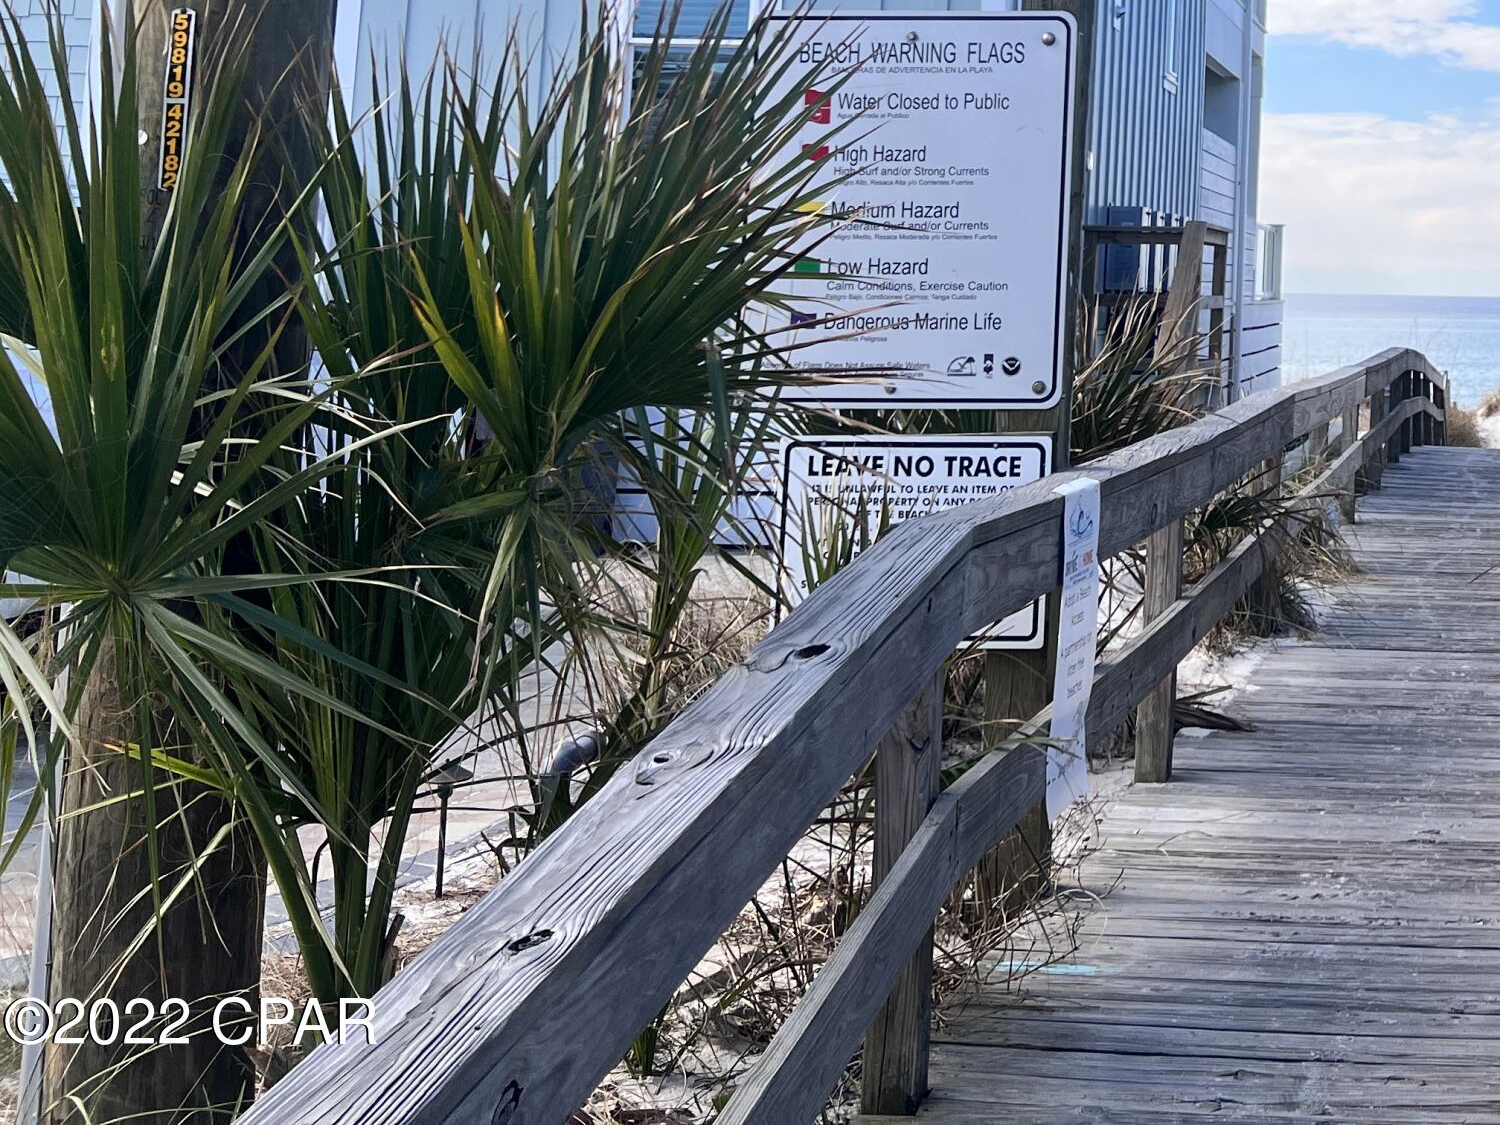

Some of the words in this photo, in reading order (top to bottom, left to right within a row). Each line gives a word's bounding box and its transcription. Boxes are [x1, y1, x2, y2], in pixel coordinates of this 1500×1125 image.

[799, 41, 861, 64] BEACH
[871, 41, 957, 64] WARNING
[967, 42, 1026, 64] FLAGS
[832, 66, 873, 74] BANRAS
[875, 66, 887, 74] DE
[888, 66, 944, 74] ADVERTENCIA
[945, 66, 957, 74] EN
[958, 66, 968, 74] LA
[969, 66, 993, 74] PLAYA
[838, 93, 881, 110] Water
[887, 92, 940, 110] Closed
[945, 94, 959, 110] to
[964, 92, 1010, 110] Public
[834, 145, 868, 167] High
[873, 145, 926, 162] Hazard
[834, 166, 856, 177] High
[859, 166, 878, 176] Surf
[881, 166, 911, 176] and/or
[914, 166, 945, 179] Strong
[948, 166, 990, 176] Currents
[832, 201, 895, 219] Medium
[902, 201, 959, 218] Hazard
[831, 220, 880, 231] Moderate
[908, 220, 940, 232] and/or
[944, 221, 989, 231] Currents
[828, 257, 862, 275] Low
[868, 257, 929, 275] Hazard
[826, 280, 855, 291] Calm
[857, 280, 916, 292] Conditions,
[919, 280, 965, 291] Exercise
[968, 280, 1008, 291] Caution
[824, 312, 909, 332] Dangerous
[914, 312, 969, 331] Marine
[973, 312, 1002, 331] Life
[807, 455, 884, 477] LEAVE
[893, 455, 934, 477] NO
[944, 456, 1022, 477] TRACE
[900, 485, 912, 493] TO
[917, 485, 950, 494] LEAVE
[952, 485, 968, 493] AN
[971, 485, 997, 494] ITEM
[922, 497, 940, 507] ON
[943, 497, 966, 507] ANY
